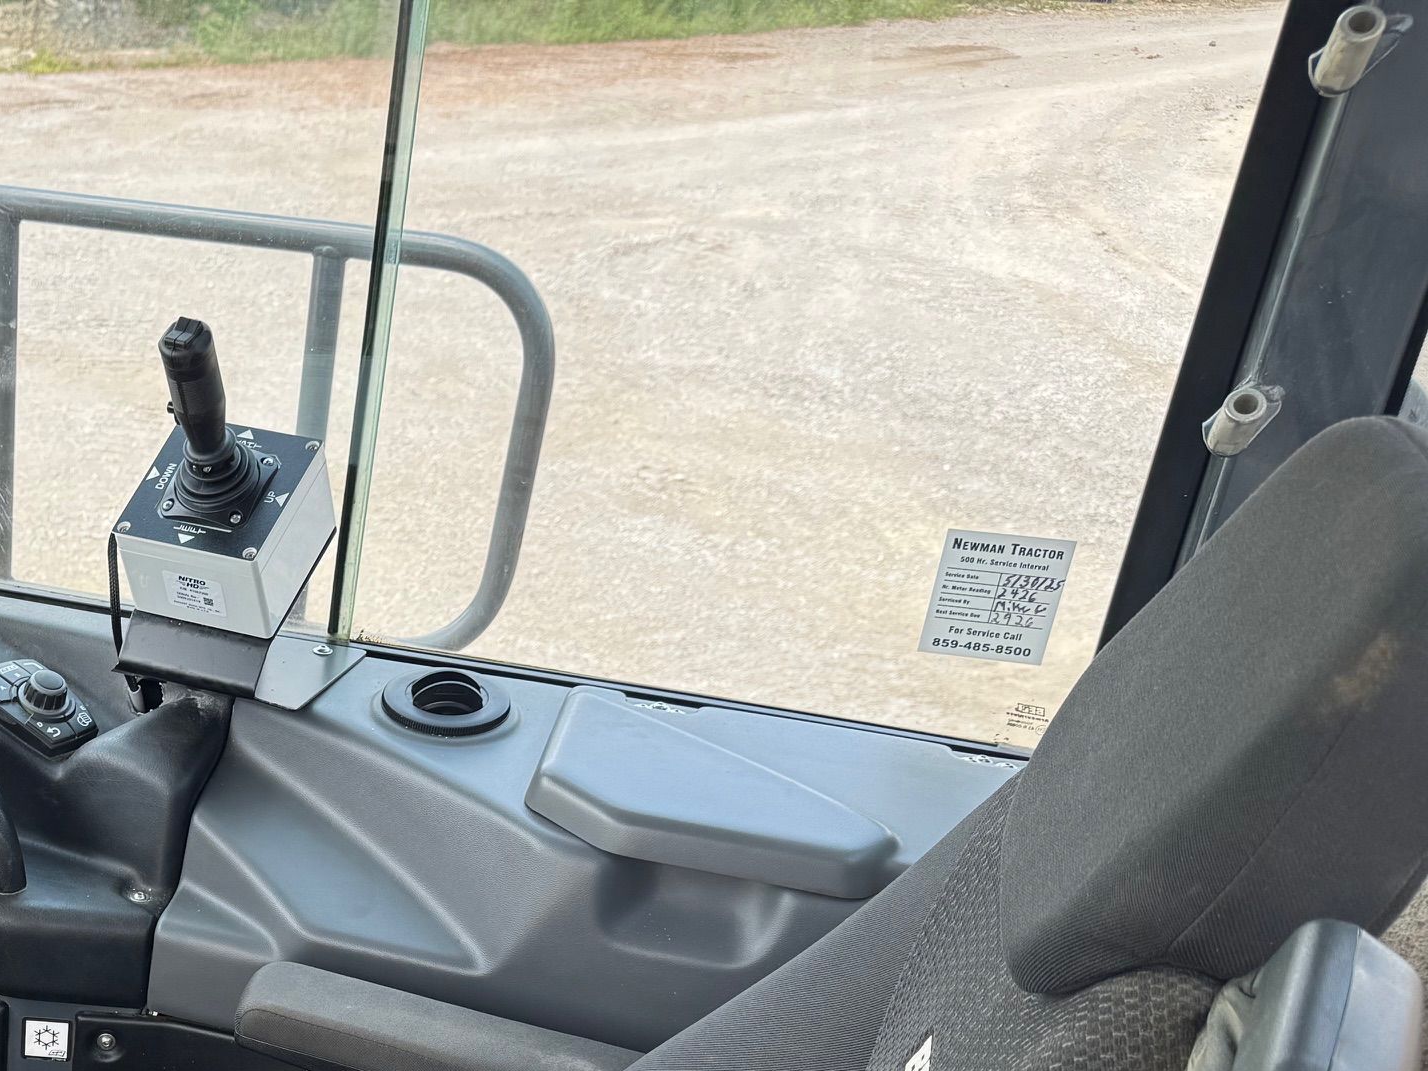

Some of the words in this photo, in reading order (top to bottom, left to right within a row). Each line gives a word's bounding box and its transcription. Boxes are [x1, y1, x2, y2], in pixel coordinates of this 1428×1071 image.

[155, 463, 177, 490] DOWN
[263, 491, 275, 503] UP
[960, 556, 974, 564] 500
[990, 559, 1018, 568] Service
[1019, 563, 1050, 572] Interval
[948, 626, 964, 635] For
[966, 627, 1000, 639] Service
[1003, 632, 1022, 641] Call
[932, 637, 1031, 657] 859-485-8500
